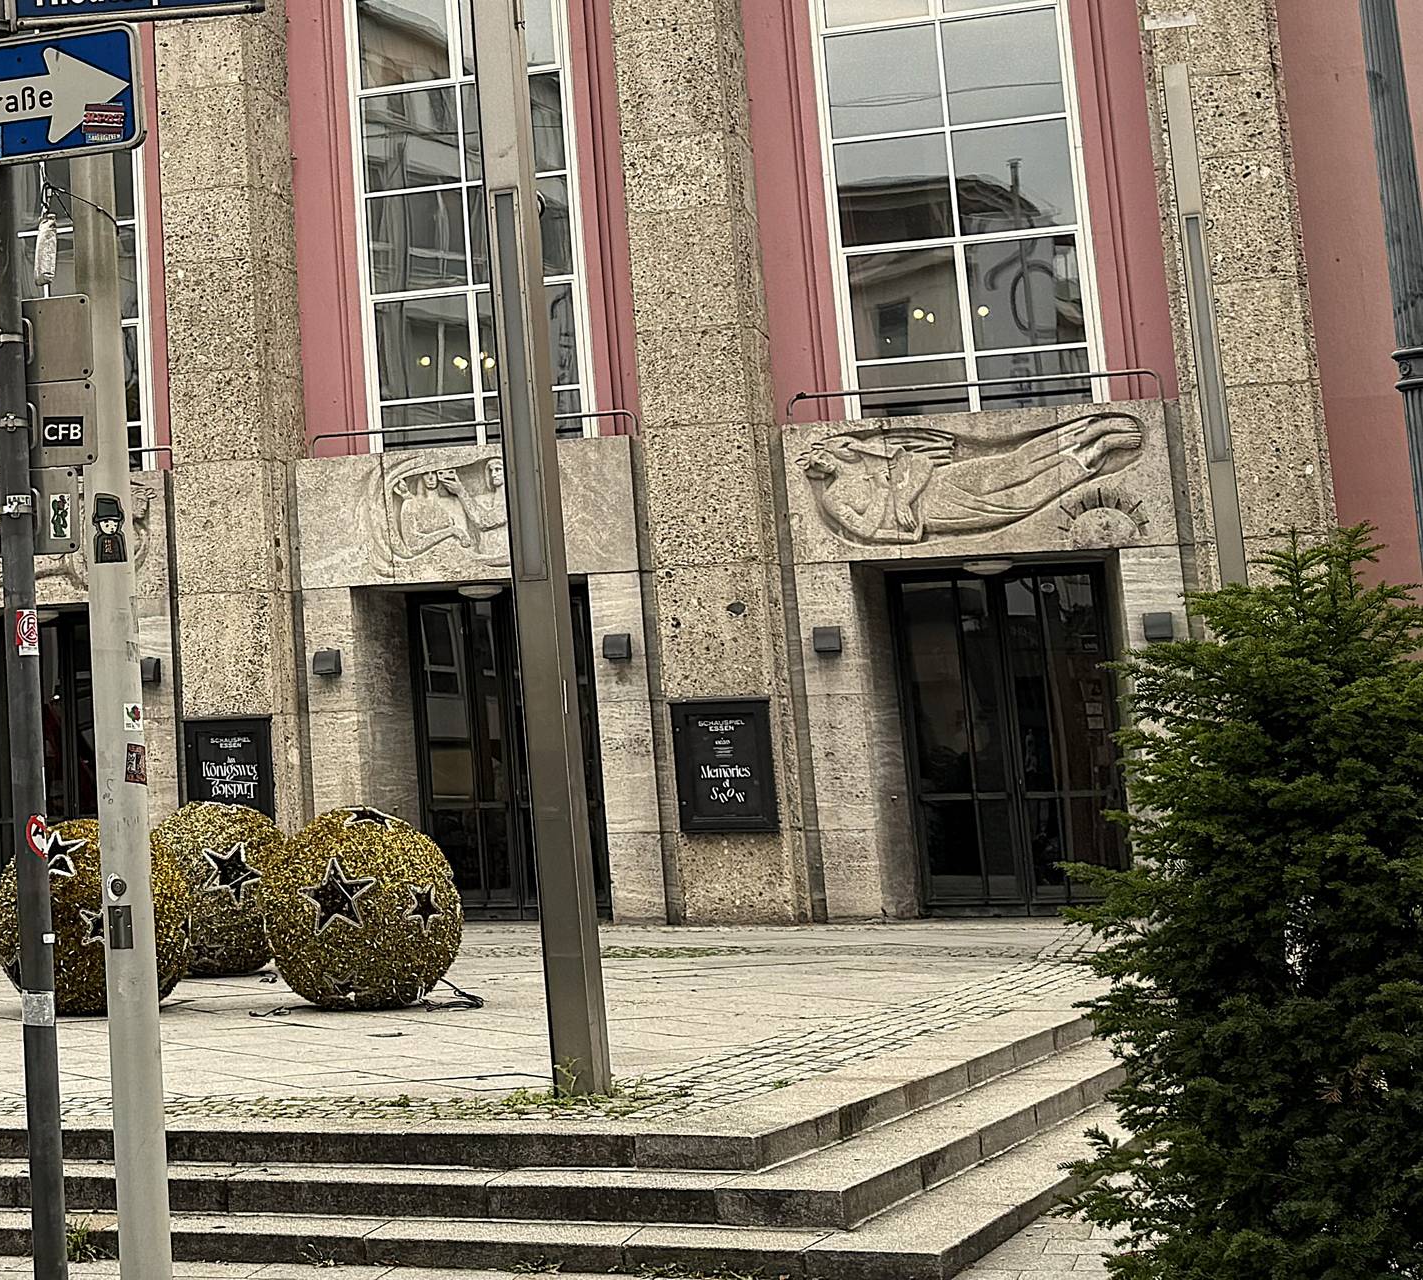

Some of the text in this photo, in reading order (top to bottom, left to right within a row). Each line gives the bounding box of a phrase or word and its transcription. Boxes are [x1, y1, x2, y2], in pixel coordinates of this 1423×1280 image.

[44, 423, 82, 440] CFB
[202, 761, 259, 781] Königsweg
[700, 764, 751, 779] Memories
